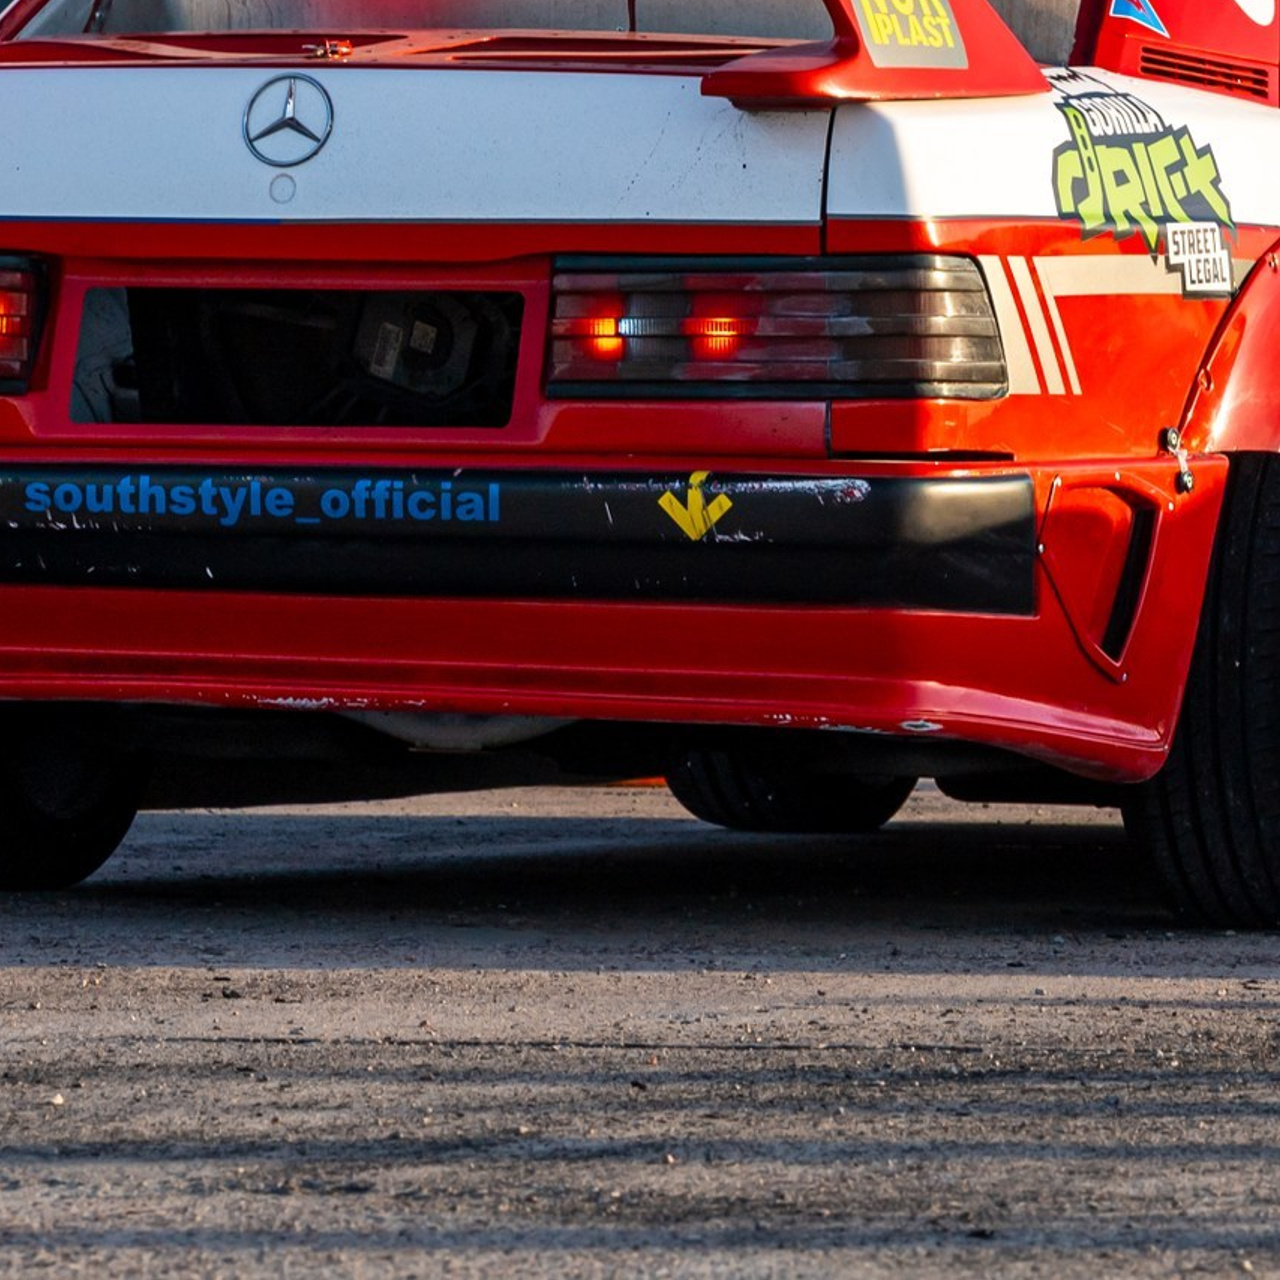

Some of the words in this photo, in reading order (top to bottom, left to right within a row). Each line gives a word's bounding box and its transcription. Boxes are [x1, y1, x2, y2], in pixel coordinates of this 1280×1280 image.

[874, 12, 954, 48] PLAST
[1172, 228, 1217, 255] STREET
[1188, 258, 1227, 285] LEGAL
[24, 474, 501, 526] southstyle_official
